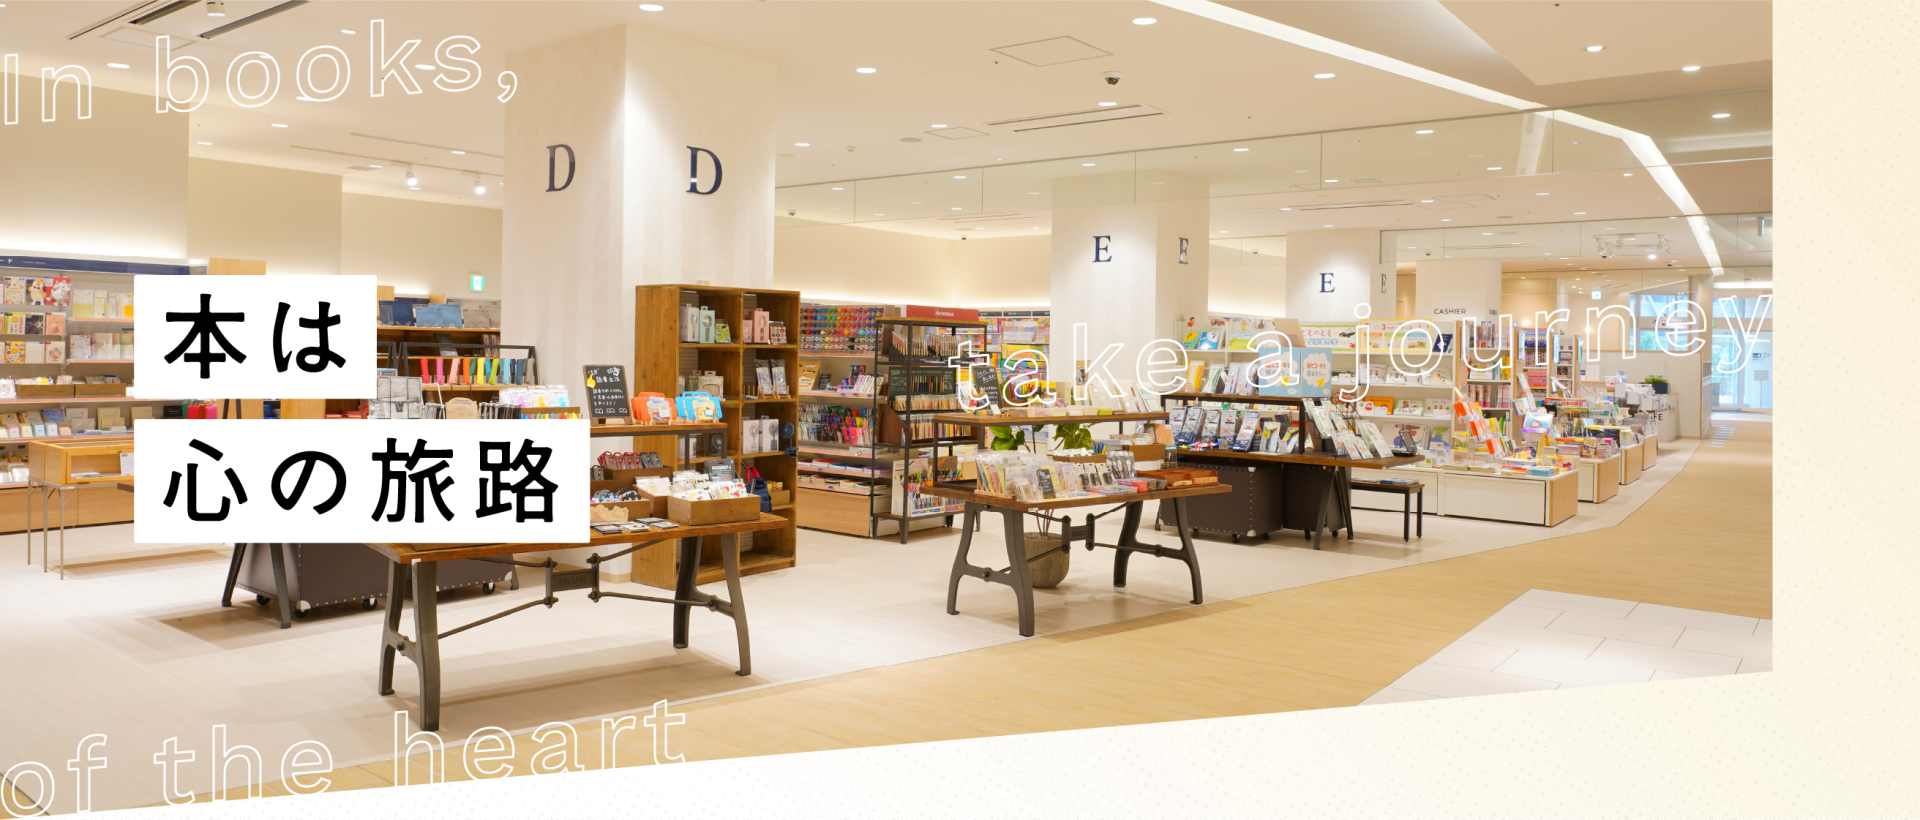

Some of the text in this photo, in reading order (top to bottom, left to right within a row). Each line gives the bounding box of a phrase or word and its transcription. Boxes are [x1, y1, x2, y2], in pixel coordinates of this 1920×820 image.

[545, 143, 577, 193] D
[686, 145, 724, 196] D
[1092, 234, 1113, 264] E
[1178, 236, 1190, 266] E
[1319, 272, 1336, 294] E
[1380, 273, 1388, 295] E
[1650, 412, 1663, 421] FE
[558, 575, 587, 586] CRASH
